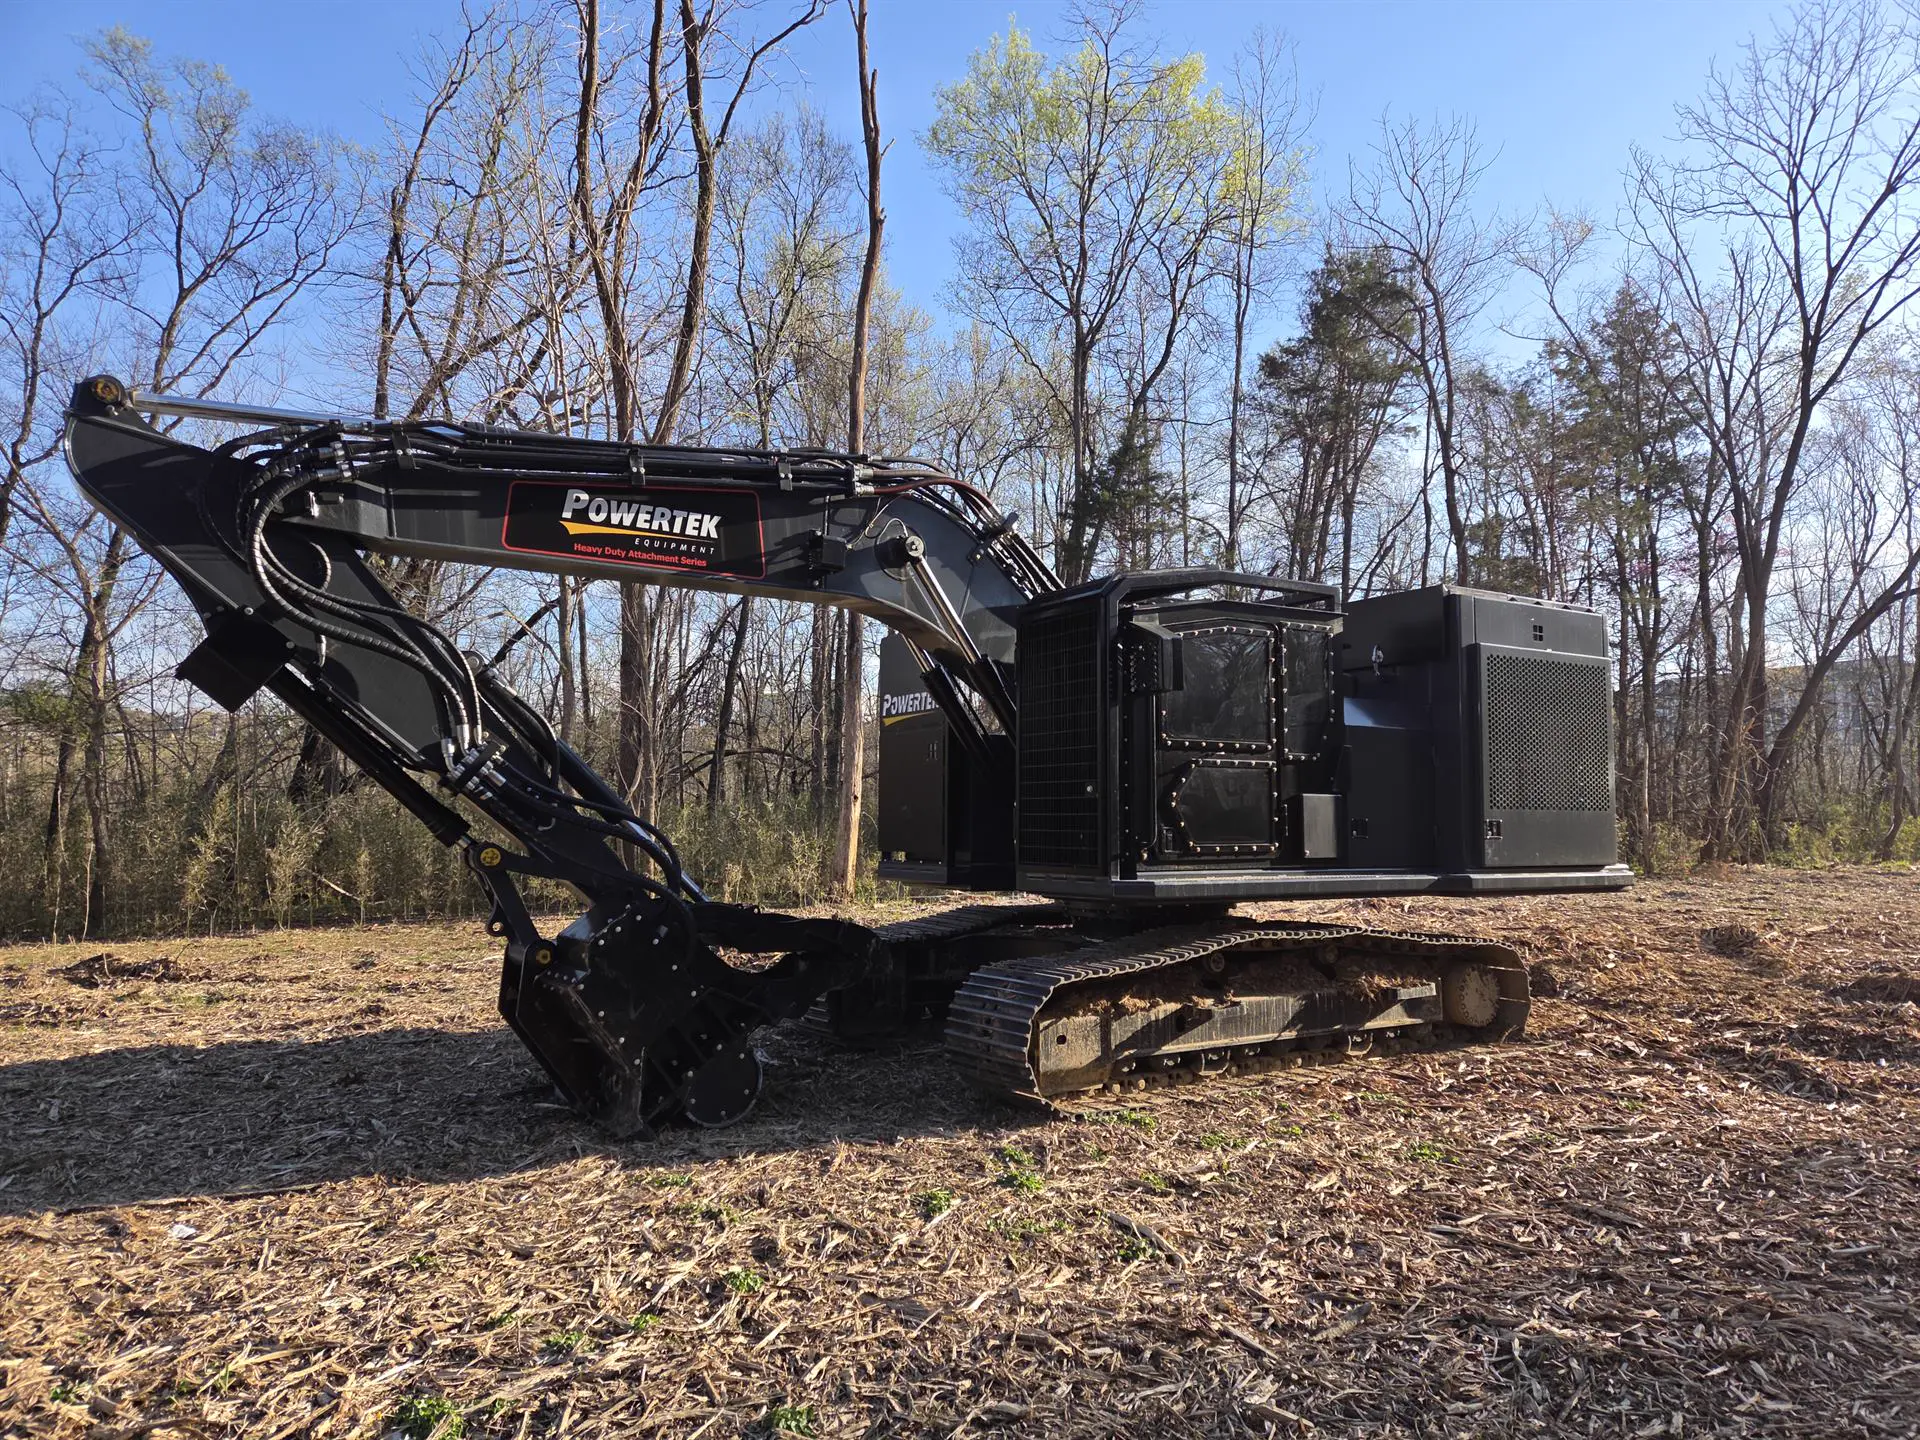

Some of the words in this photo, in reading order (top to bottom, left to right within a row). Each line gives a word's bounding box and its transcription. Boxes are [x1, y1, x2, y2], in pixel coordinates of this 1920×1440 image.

[561, 489, 722, 538] POWERTEK
[574, 543, 602, 555] Heavy
[605, 545, 626, 558] Duty
[628, 548, 679, 564] Attachment
[680, 556, 707, 567] Series
[635, 538, 715, 554] EQUIPMENT
